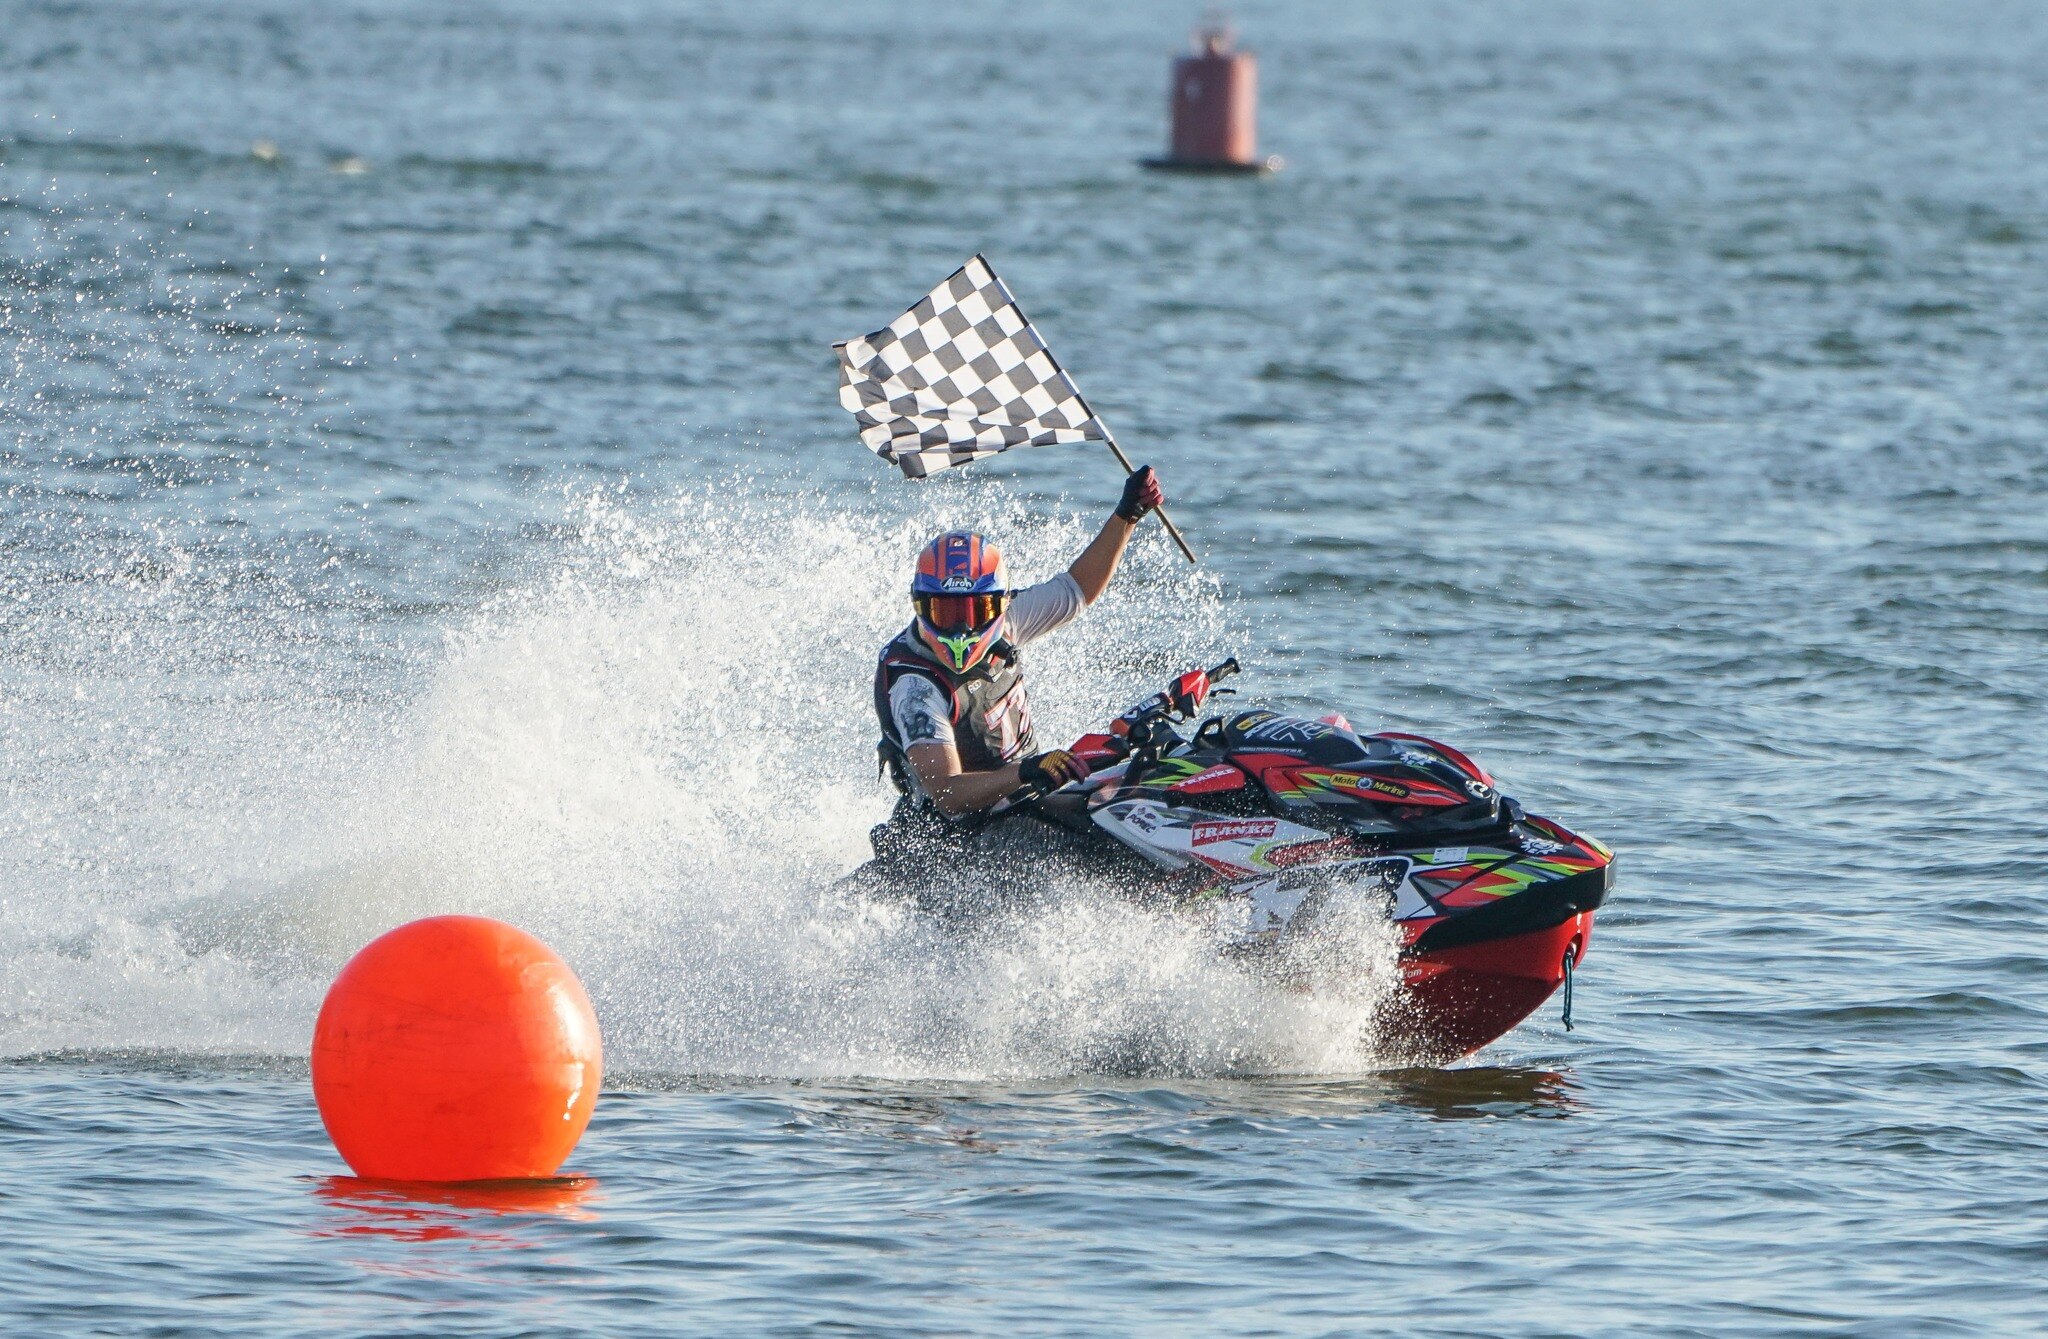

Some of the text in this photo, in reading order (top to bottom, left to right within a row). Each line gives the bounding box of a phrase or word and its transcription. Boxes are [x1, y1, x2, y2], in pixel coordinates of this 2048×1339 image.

[943, 577, 972, 588] Airoh
[1332, 776, 1406, 796] Moto Marine
[1193, 824, 1275, 841] FRANKE
